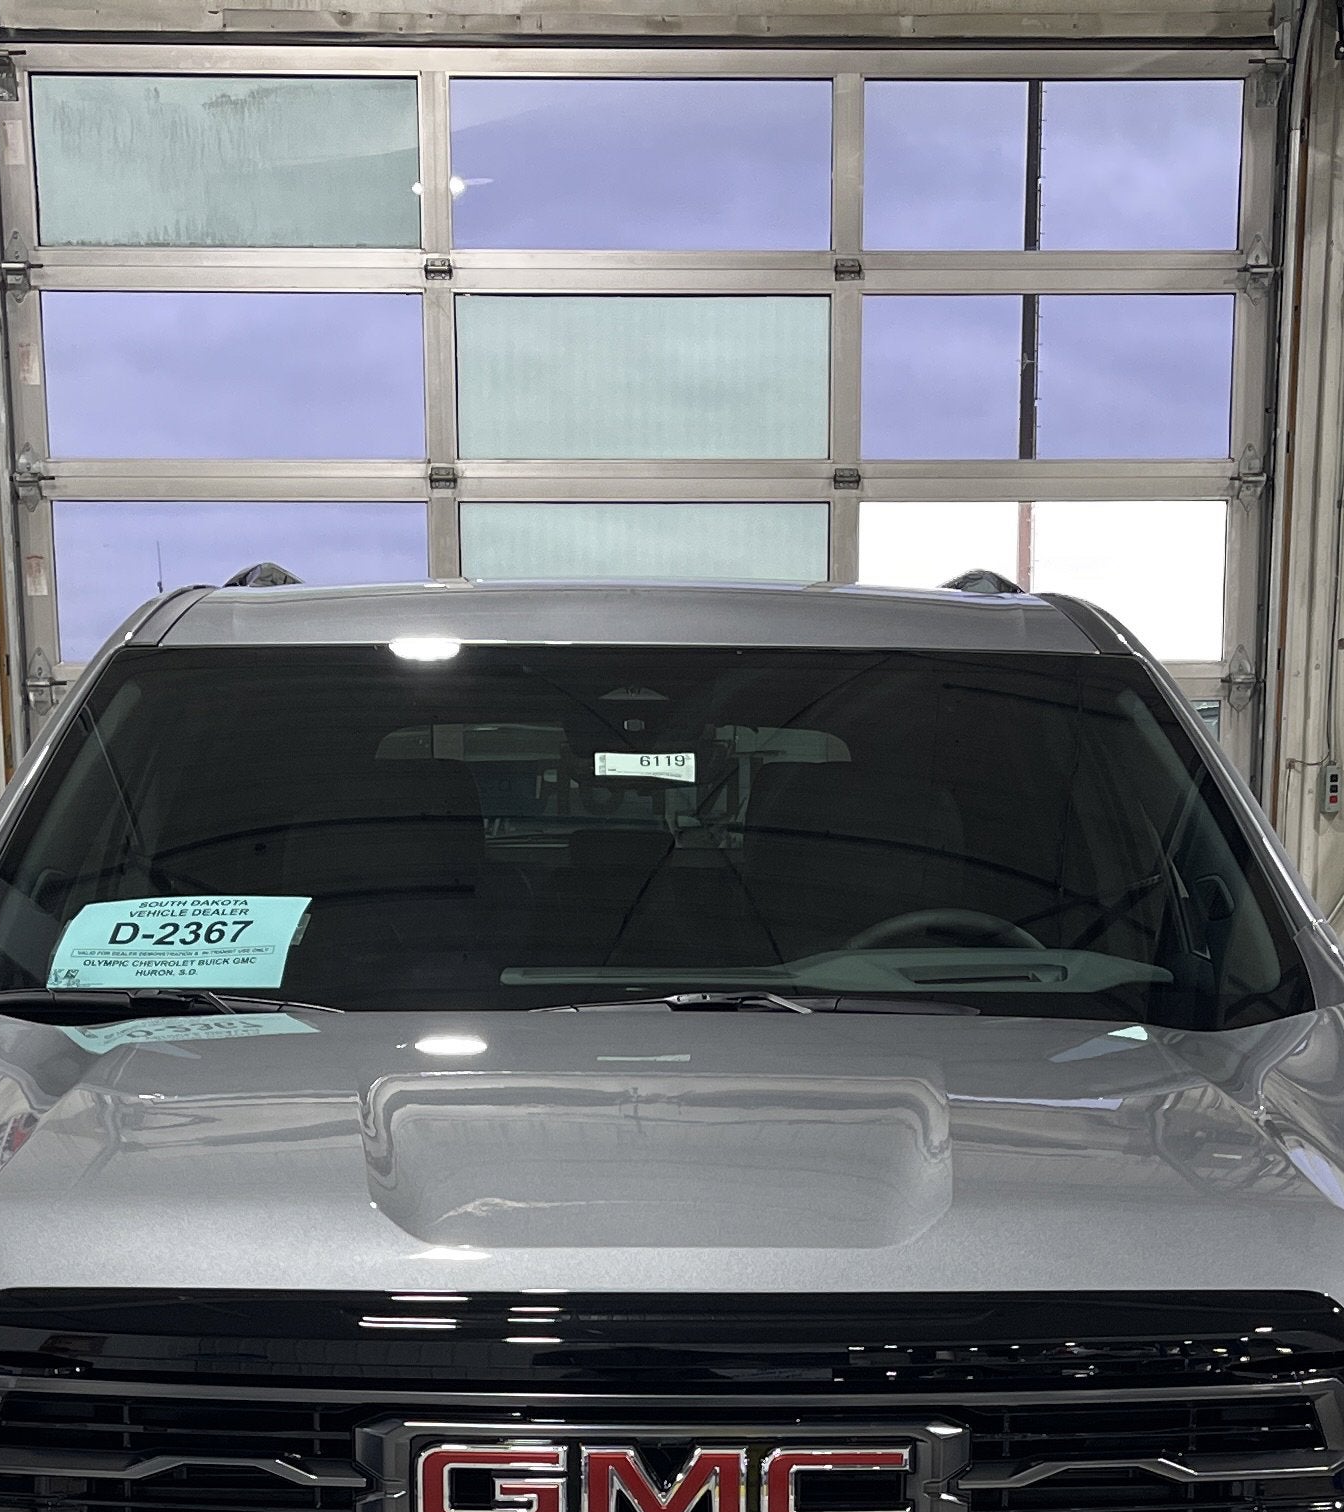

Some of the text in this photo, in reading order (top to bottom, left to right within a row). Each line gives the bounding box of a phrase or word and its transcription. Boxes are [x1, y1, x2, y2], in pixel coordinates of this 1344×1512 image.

[640, 755, 686, 767] 6119
[129, 909, 188, 917] VEHICLE
[108, 921, 254, 945] D-2367
[198, 958, 229, 966] BUICK
